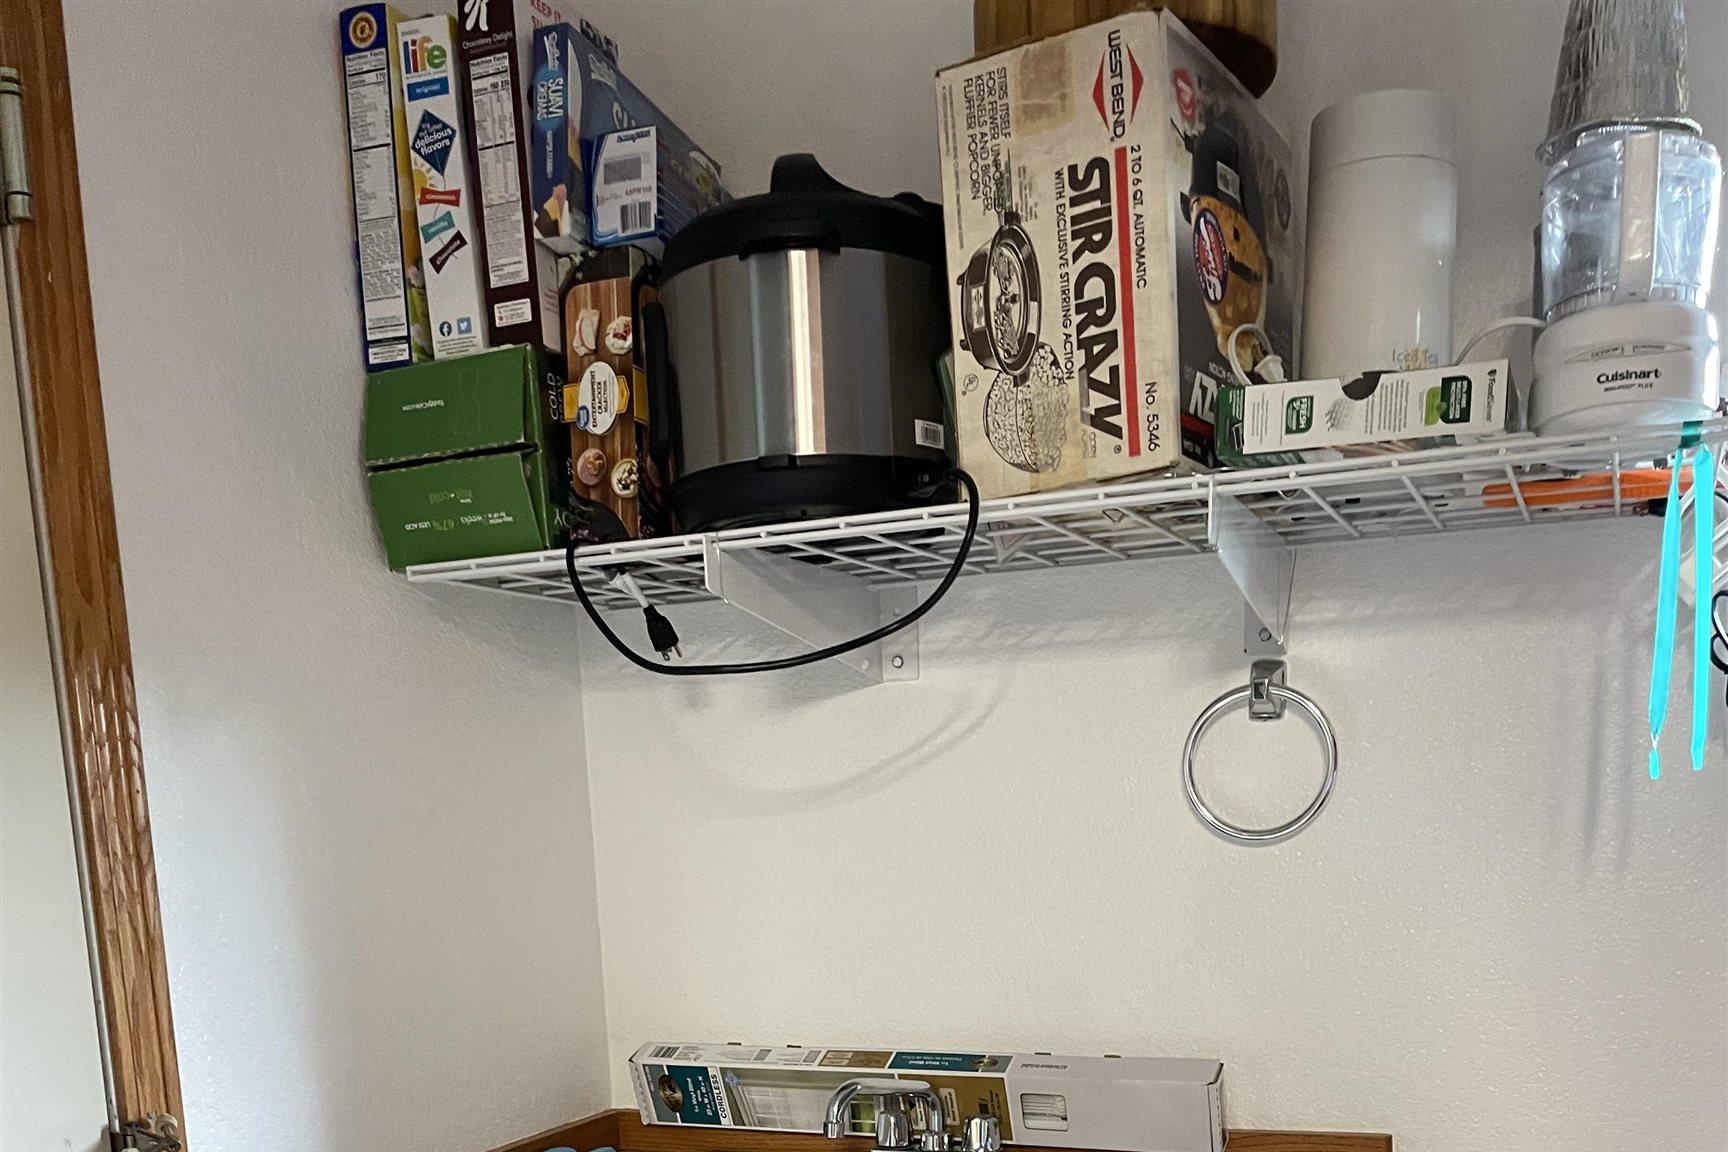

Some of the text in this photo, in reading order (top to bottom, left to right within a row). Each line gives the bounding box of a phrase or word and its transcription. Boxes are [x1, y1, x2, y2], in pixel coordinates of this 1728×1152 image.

[402, 36, 447, 75] life
[492, 30, 514, 43] Delight
[415, 84, 441, 94] original
[547, 77, 564, 118] SUAVI
[975, 74, 986, 128] KERNELS
[985, 70, 997, 99] FOR
[997, 66, 1011, 139] STIRS ITSELF
[1108, 29, 1125, 138] WEST BEND
[414, 128, 453, 149] delicious
[964, 78, 981, 201] FLUFFIER POPCORN
[988, 100, 999, 141] FEWER
[420, 139, 451, 156] flavors
[979, 131, 990, 160] AND
[1130, 144, 1141, 154] 2
[1131, 155, 1142, 174] TO
[1132, 177, 1142, 187] 6
[1134, 213, 1147, 289] AUTOMATIC
[1055, 167, 1075, 380] WITH EXCLUSIVE STIRRING ACTION
[1067, 156, 1123, 440] STIR CRAZY
[547, 372, 559, 420] COLD
[1596, 368, 1660, 384] Cuisinart
[1145, 381, 1160, 452] No. 5346
[1299, 397, 1307, 428] FRESH
[711, 1074, 728, 1119] CORDLESS
